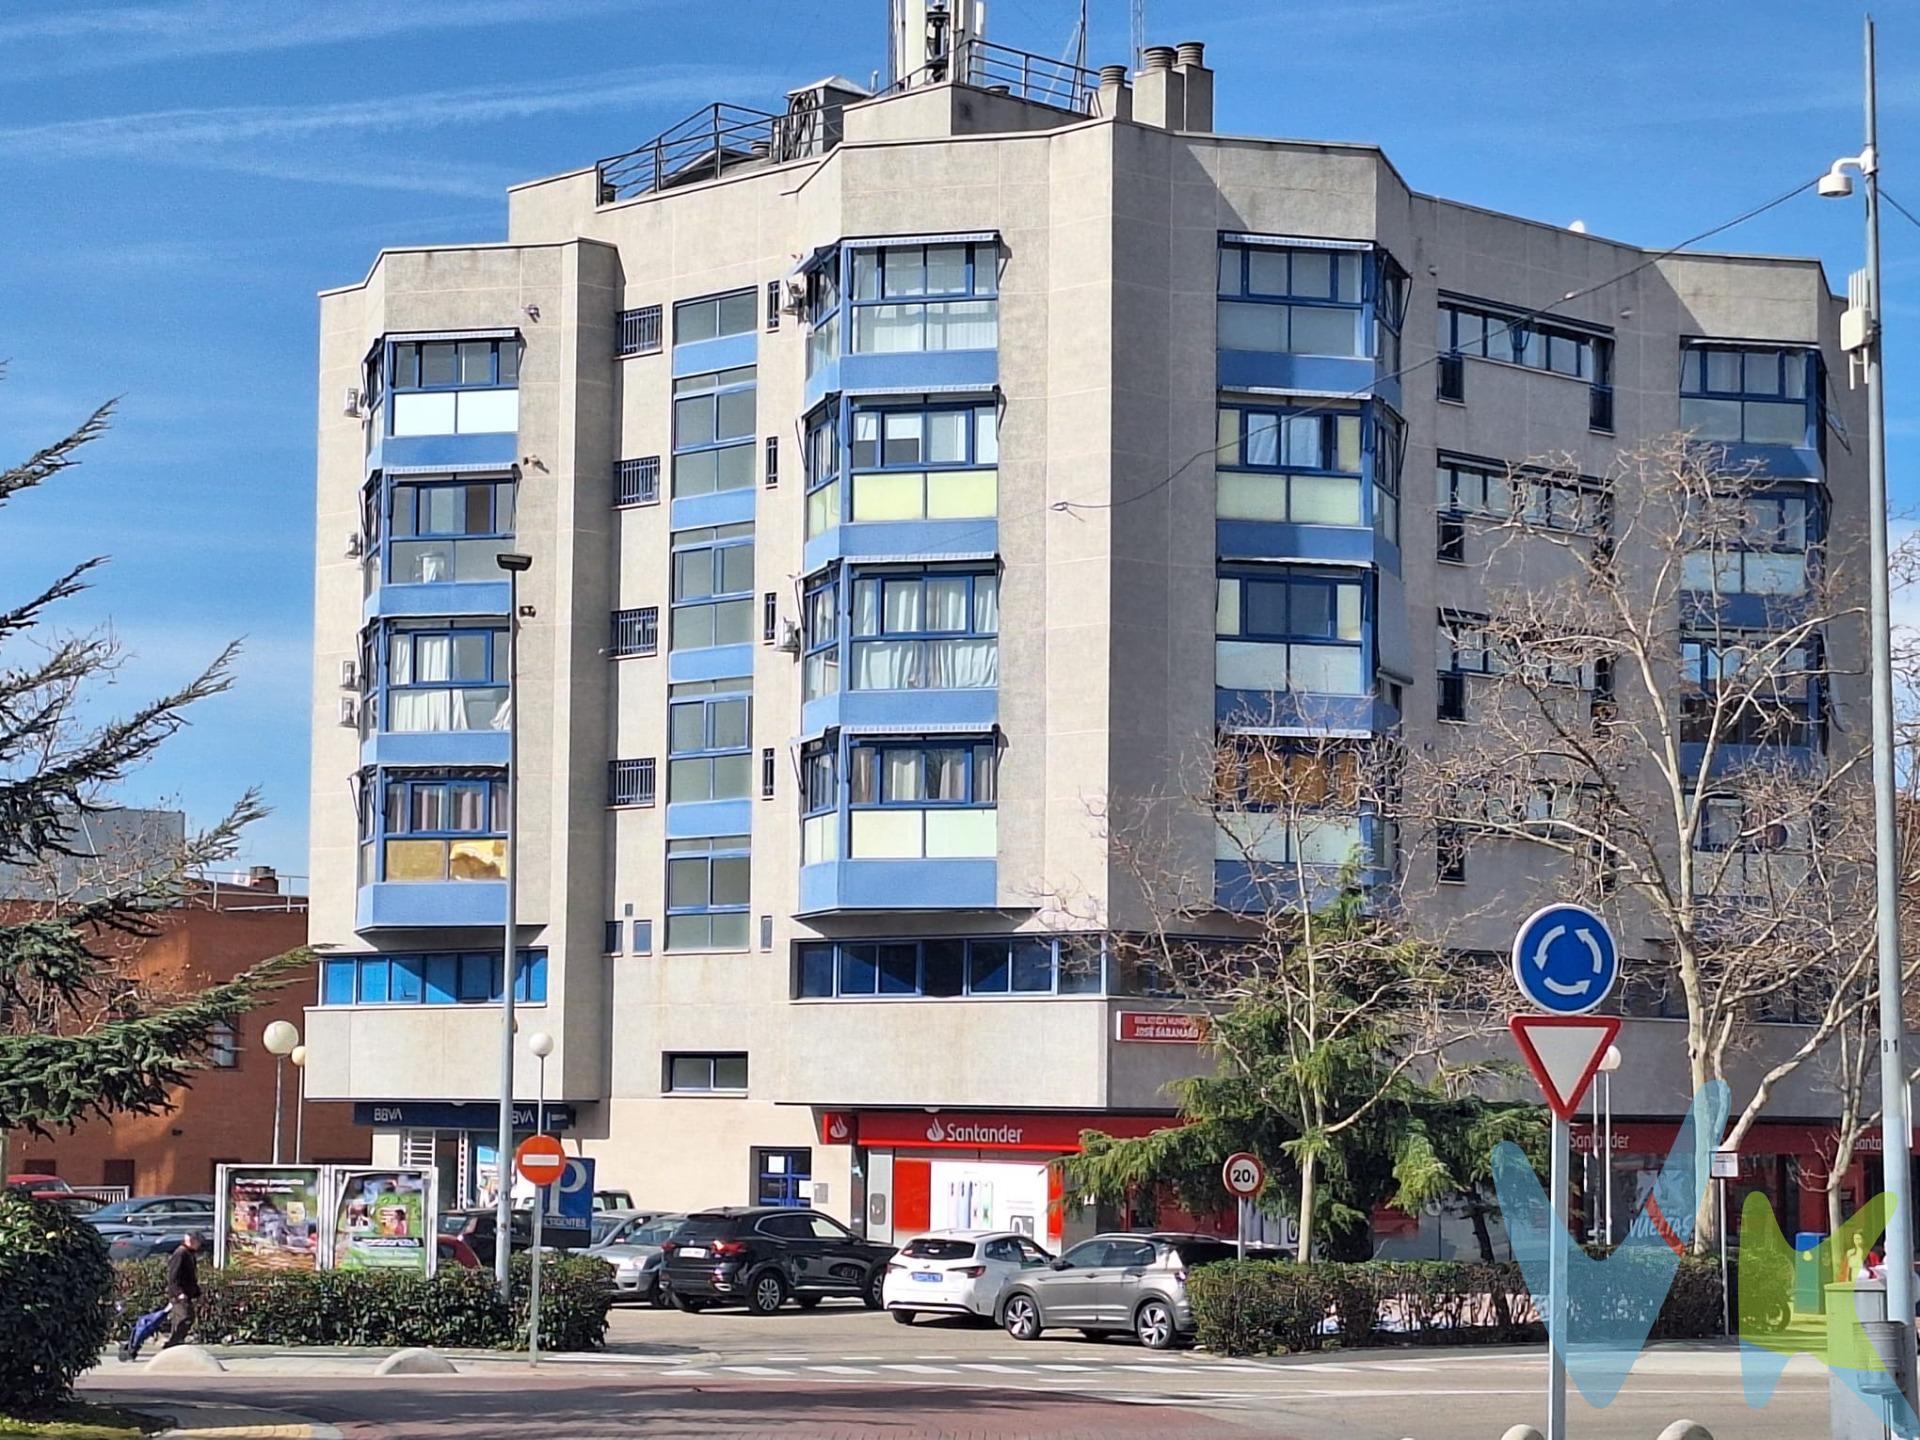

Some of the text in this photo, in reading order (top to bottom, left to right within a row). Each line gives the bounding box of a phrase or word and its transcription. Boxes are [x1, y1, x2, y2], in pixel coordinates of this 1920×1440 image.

[374, 1108, 402, 1121] BBVA
[512, 1110, 533, 1125] BVA
[947, 1123, 1023, 1143] Santander
[1569, 1131, 1630, 1149] Santader
[544, 1160, 587, 1217] P
[1629, 1214, 1692, 1239] VUELTAS
